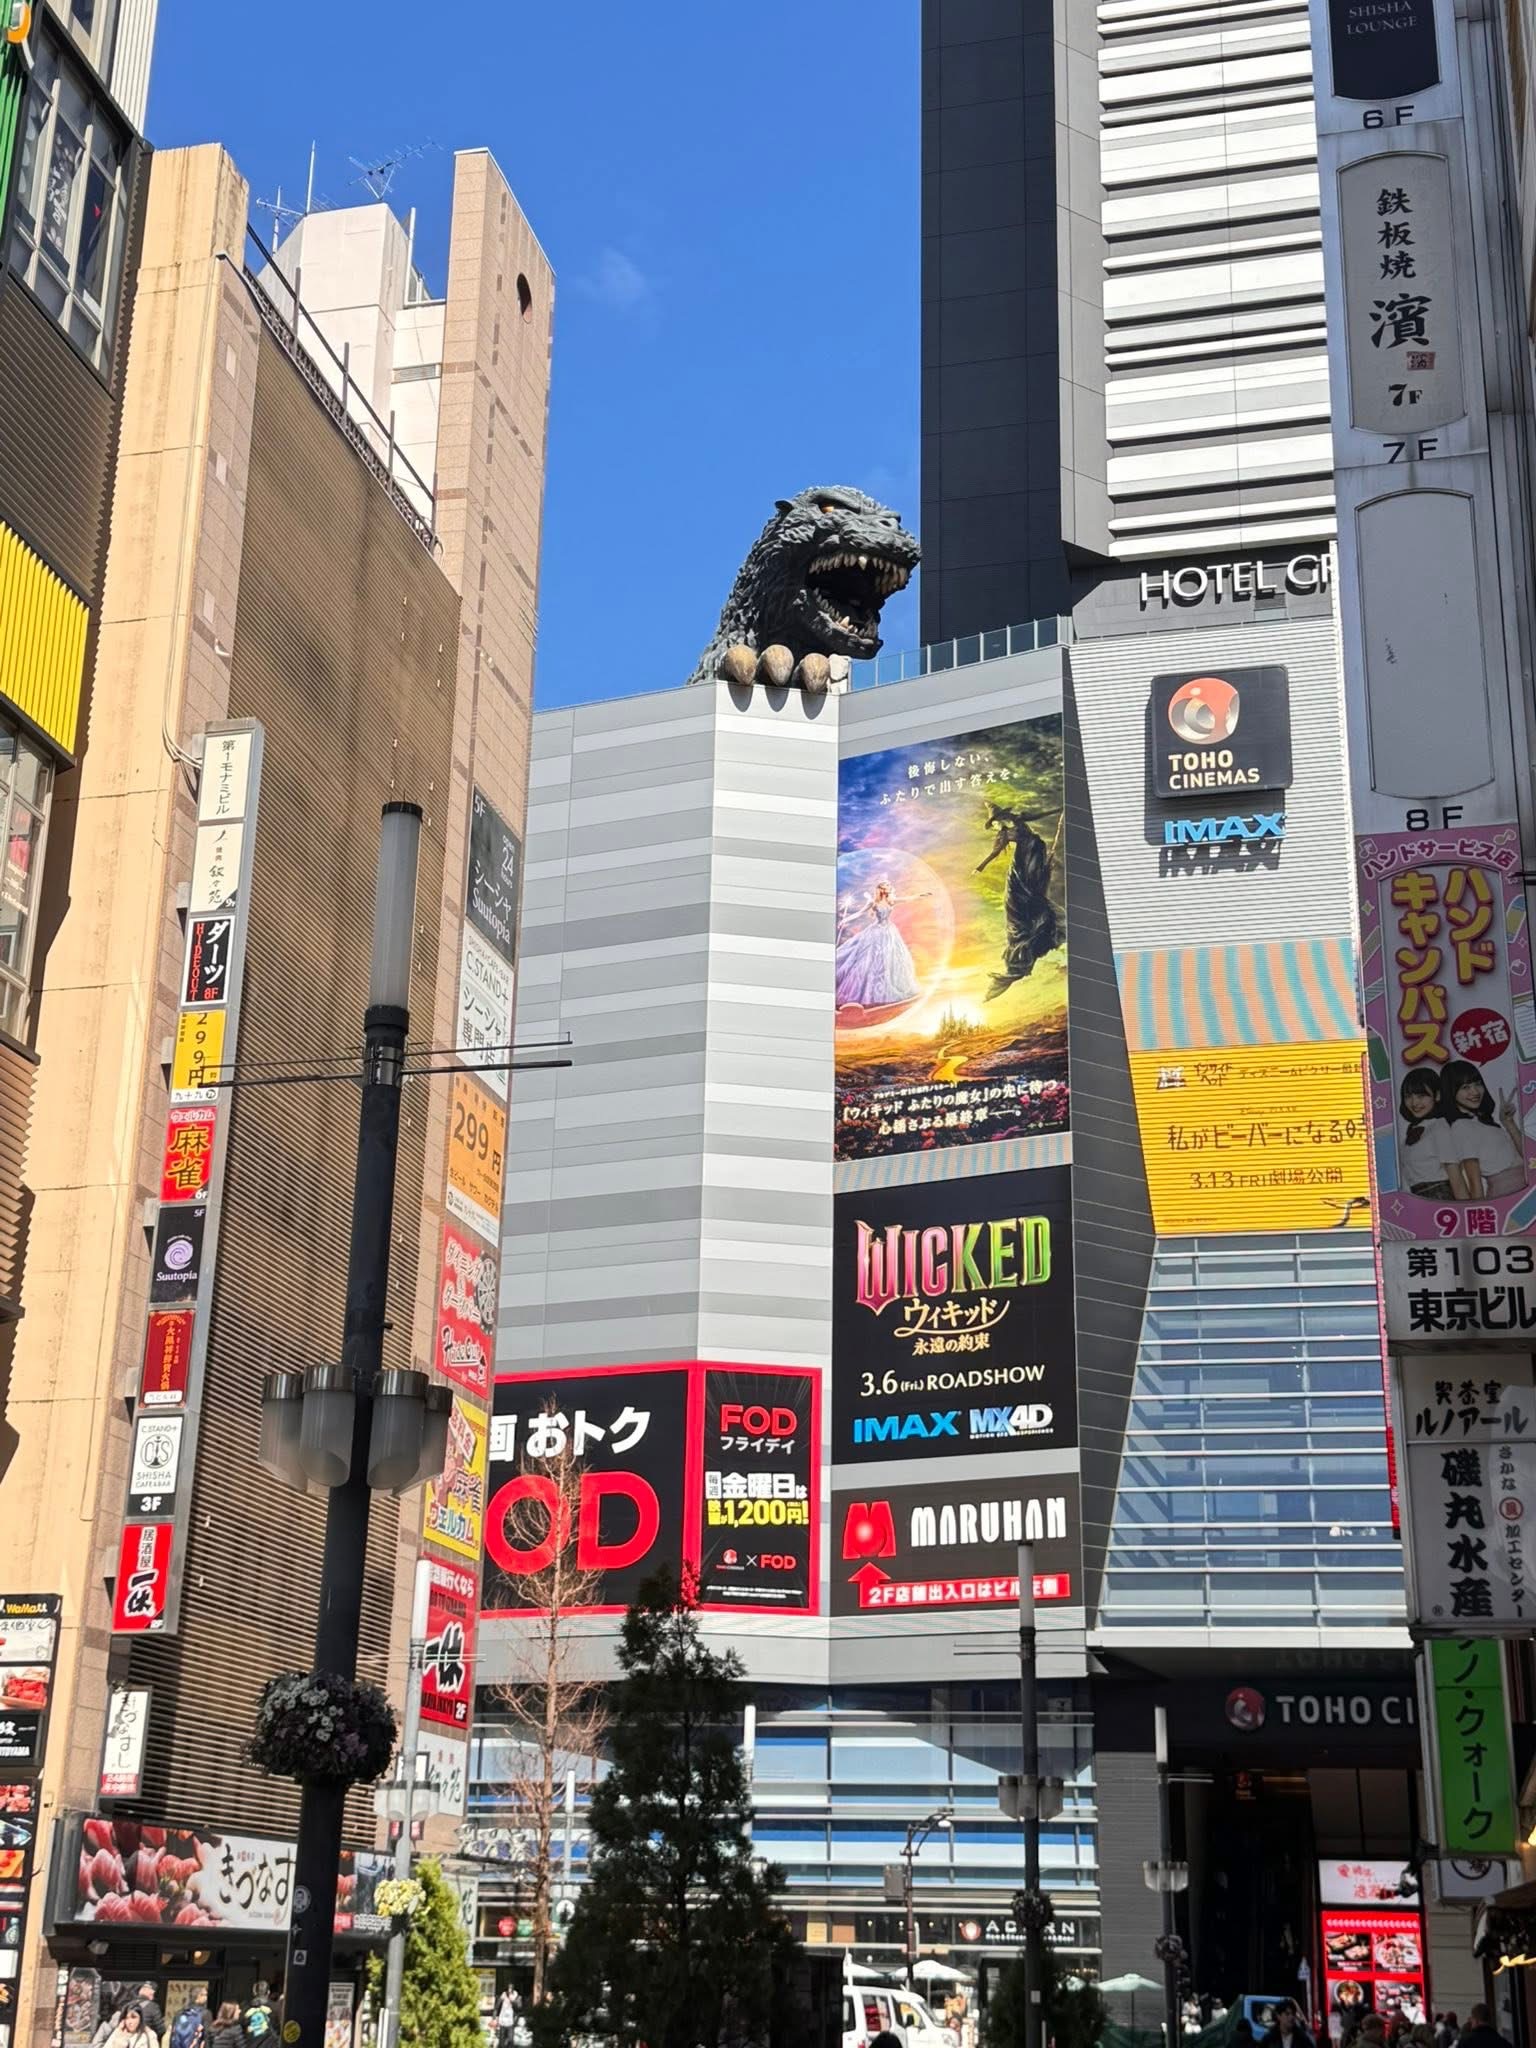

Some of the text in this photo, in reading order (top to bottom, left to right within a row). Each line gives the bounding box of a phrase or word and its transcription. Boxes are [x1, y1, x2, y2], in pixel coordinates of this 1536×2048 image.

[1346, 16, 1418, 35] LOUNGE
[1348, 0, 1412, 19] SHISHA
[1368, 292, 1433, 350] 濱
[1387, 383, 1424, 407] 7F
[1140, 559, 1278, 602] HOTEL
[907, 753, 991, 779] 後悔しない、
[1168, 749, 1234, 773] TOHO
[879, 768, 1019, 806] ふたりで出す答えを。
[1168, 768, 1261, 791] CINEMAS
[473, 794, 487, 818] 5F
[1164, 812, 1287, 845] IMAX
[501, 847, 515, 878] 24
[1362, 838, 1519, 880] ハンドサービス店
[474, 859, 513, 922] シーシャ
[472, 887, 511, 945] Suutopia
[1443, 865, 1496, 986] ハンド
[189, 922, 205, 1001] HIDEOUT
[204, 920, 230, 985] ダーツ
[1390, 869, 1452, 1066] キャンパス
[462, 985, 502, 1041] シーシャ
[1453, 1019, 1510, 1054] 新宿
[167, 1123, 209, 1189] 麻雀
[453, 1100, 489, 1162] 299
[490, 1149, 502, 1177] 円
[194, 1188, 209, 1200] 6F
[1189, 1171, 1235, 1189] 3.13
[193, 1208, 206, 1218] 5F
[1433, 1206, 1498, 1237] 9階
[156, 1271, 199, 1283] Suutopia
[853, 1214, 1053, 1317] WICKED
[1406, 1245, 1535, 1280] 第103
[902, 1296, 1000, 1332] ウィキッド
[1406, 1285, 1536, 1333] 東京ビル
[911, 1331, 991, 1357] 永遠の約束
[860, 1369, 899, 1397] 3.6
[926, 1364, 1046, 1391] ROADSHOW
[525, 1406, 651, 1459] おトク
[719, 1403, 798, 1436] FOD
[852, 1403, 1055, 1443] IMAX MX4D
[1415, 1405, 1529, 1436] ルノアール
[719, 1436, 796, 1455] フライデイ
[136, 1471, 172, 1480] SHISHA
[1498, 1445, 1517, 1492] さかな
[140, 1495, 162, 1512] 3F
[429, 1499, 477, 1549] ウェルカム
[910, 1496, 1067, 1548] MARUHAN
[1439, 1447, 1495, 1619] 磯丸水産
[761, 1553, 797, 1570] FOD
[1504, 1525, 1528, 1619] 加工センター
[126, 1571, 158, 1616] 一休
[1275, 1696, 1415, 1725] TOHO CI
[985, 1919, 1075, 1935] ACRN
